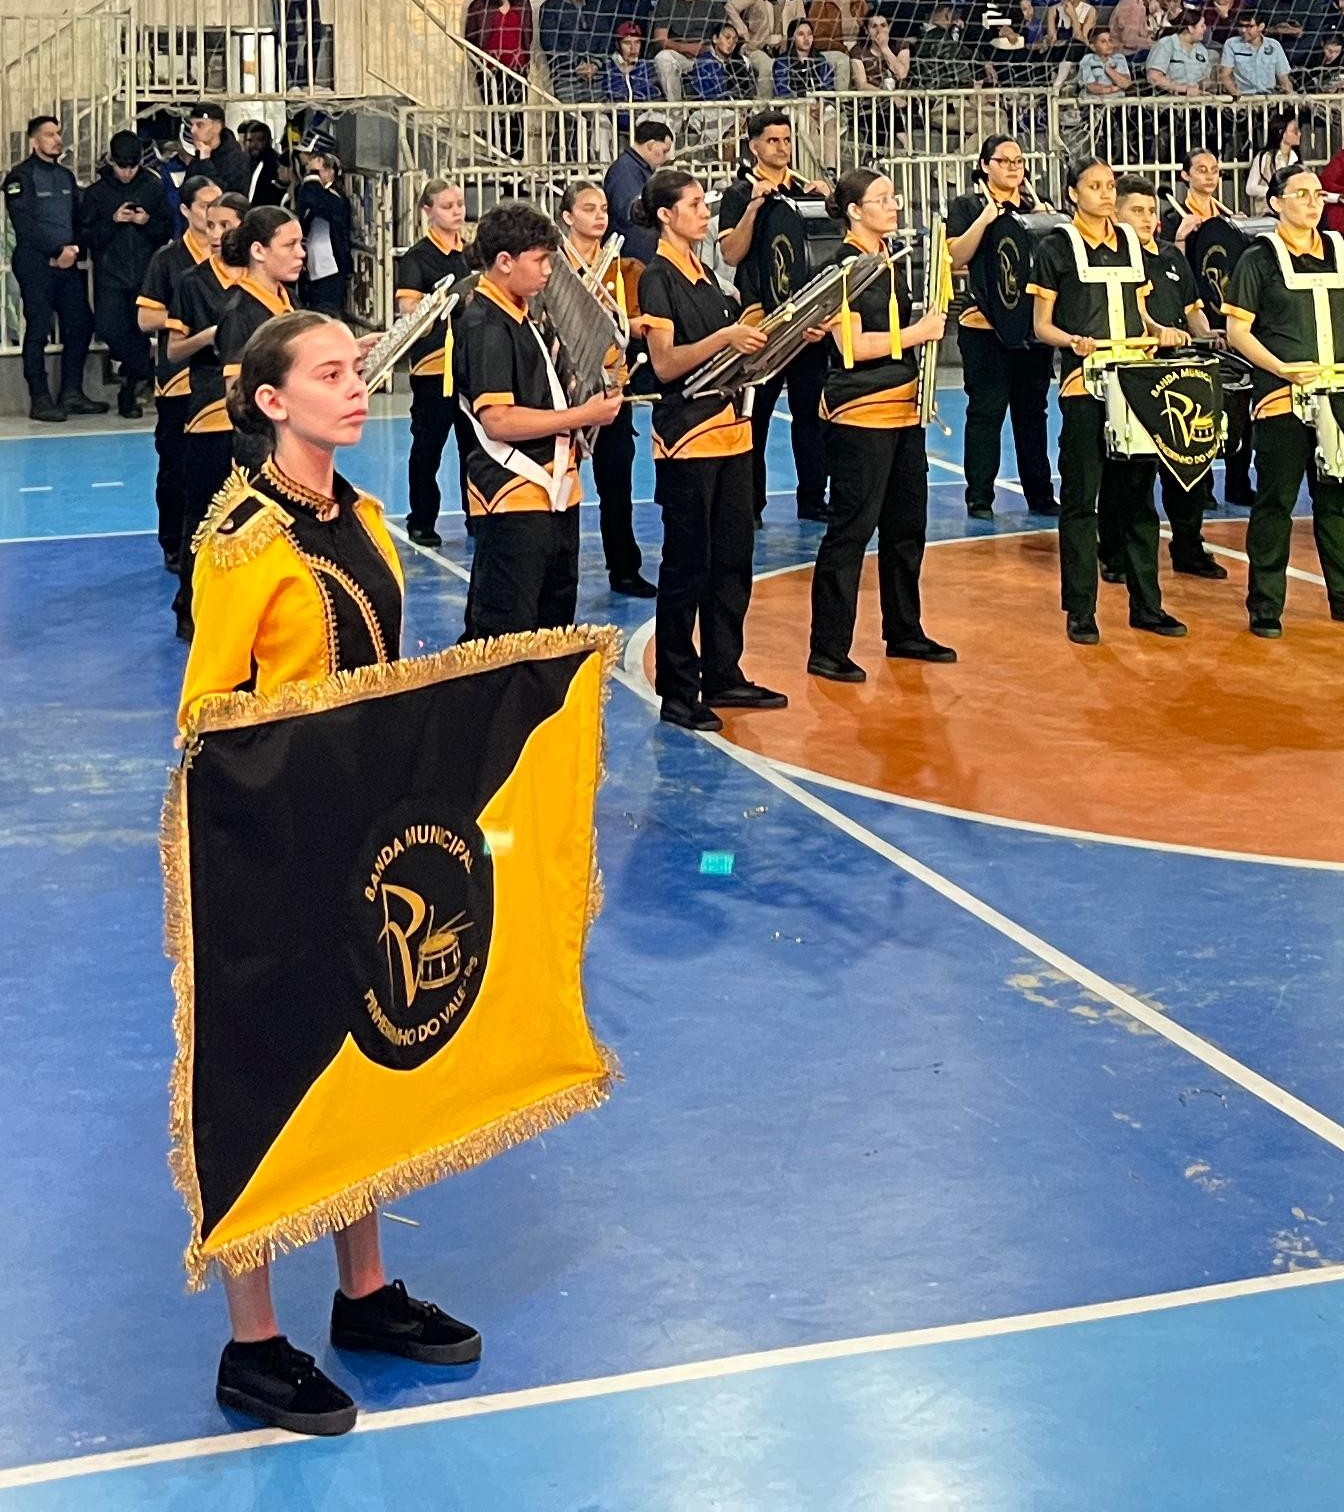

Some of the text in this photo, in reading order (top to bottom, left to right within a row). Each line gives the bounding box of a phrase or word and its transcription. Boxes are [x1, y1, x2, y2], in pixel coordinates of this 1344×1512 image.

[364, 837, 405, 902] BANDA
[418, 1018, 440, 1042] DO
[439, 985, 466, 1024] VALE
